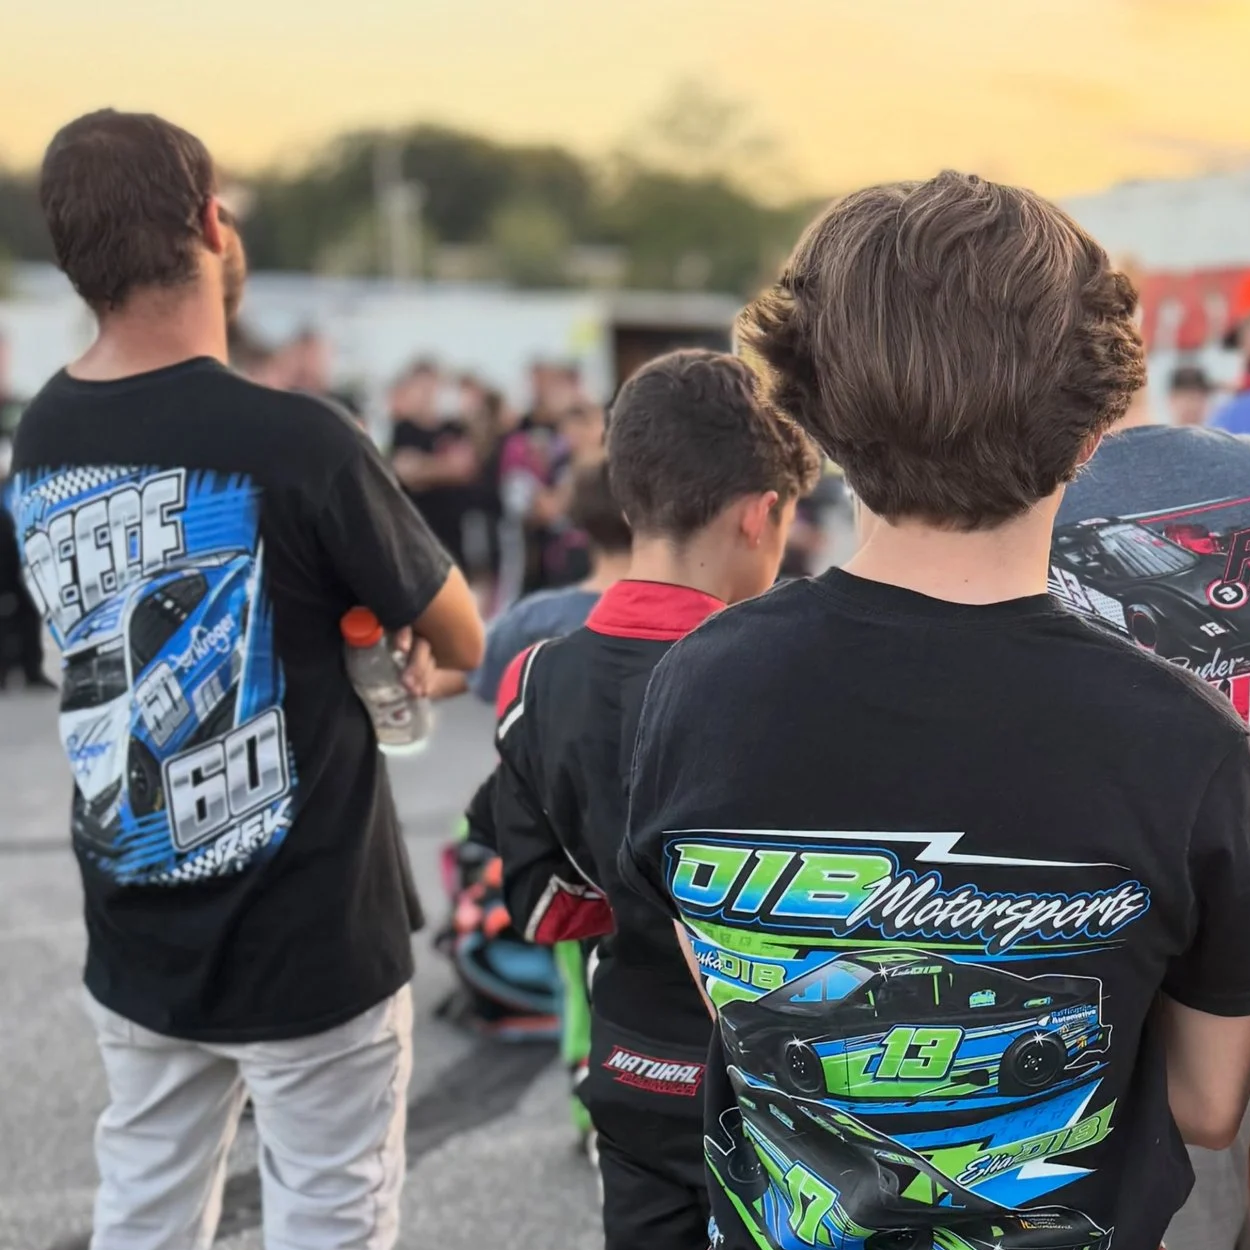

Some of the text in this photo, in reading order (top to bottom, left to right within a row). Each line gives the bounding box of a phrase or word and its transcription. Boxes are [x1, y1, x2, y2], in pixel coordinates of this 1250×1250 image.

[133, 661, 190, 747] 60
[163, 706, 289, 852] 60
[673, 844, 1144, 946] DIB Motorsports
[608, 1051, 701, 1084] NATURAL
[877, 1027, 963, 1080] 13
[784, 1163, 838, 1245] 17
